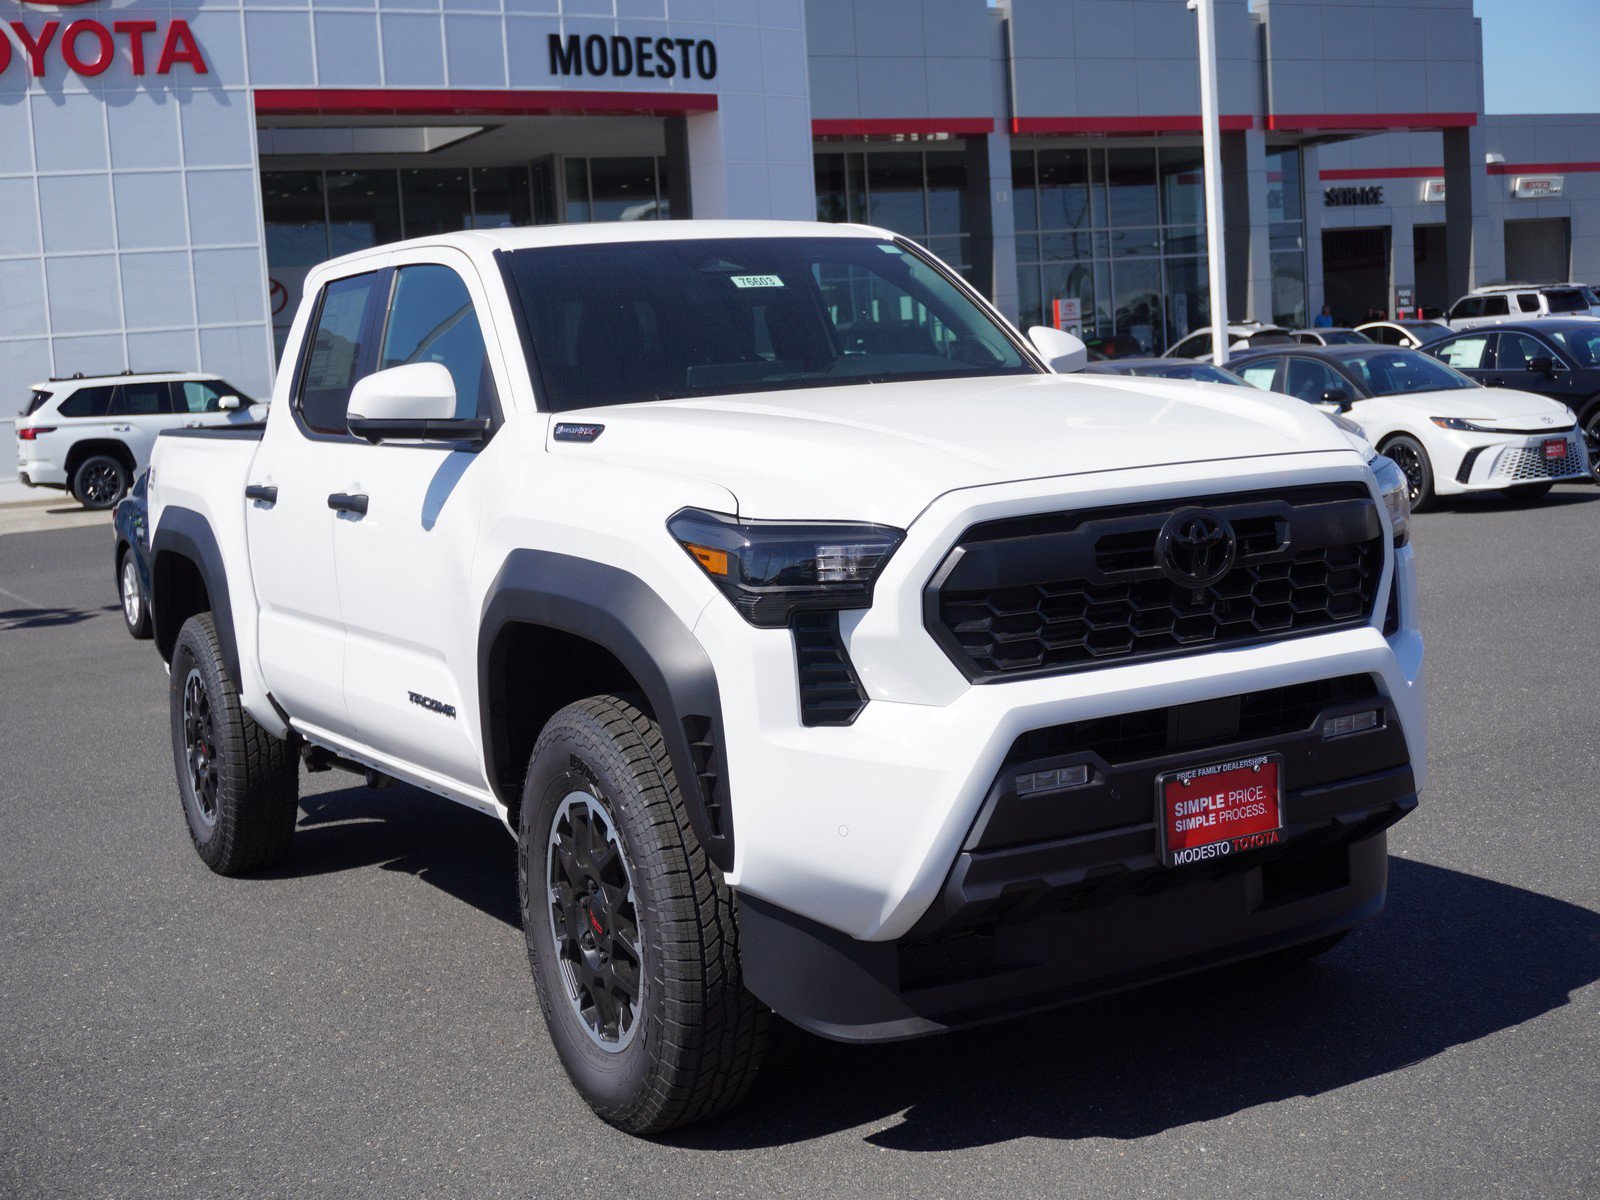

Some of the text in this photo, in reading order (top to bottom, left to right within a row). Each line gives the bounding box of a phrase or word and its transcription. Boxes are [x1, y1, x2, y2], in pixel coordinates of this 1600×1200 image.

[0, 19, 209, 77] YOTA
[547, 33, 718, 80] MODESTO
[1323, 186, 1384, 207] SERVICE
[1176, 756, 1268, 781] PRICE FAMILY DEALERSHIPS
[1175, 785, 1267, 817] SIMPLE PRICE.
[1175, 803, 1268, 832] SIMPLE PROCESS.
[1174, 831, 1279, 865] MODESTO TOYOTA
